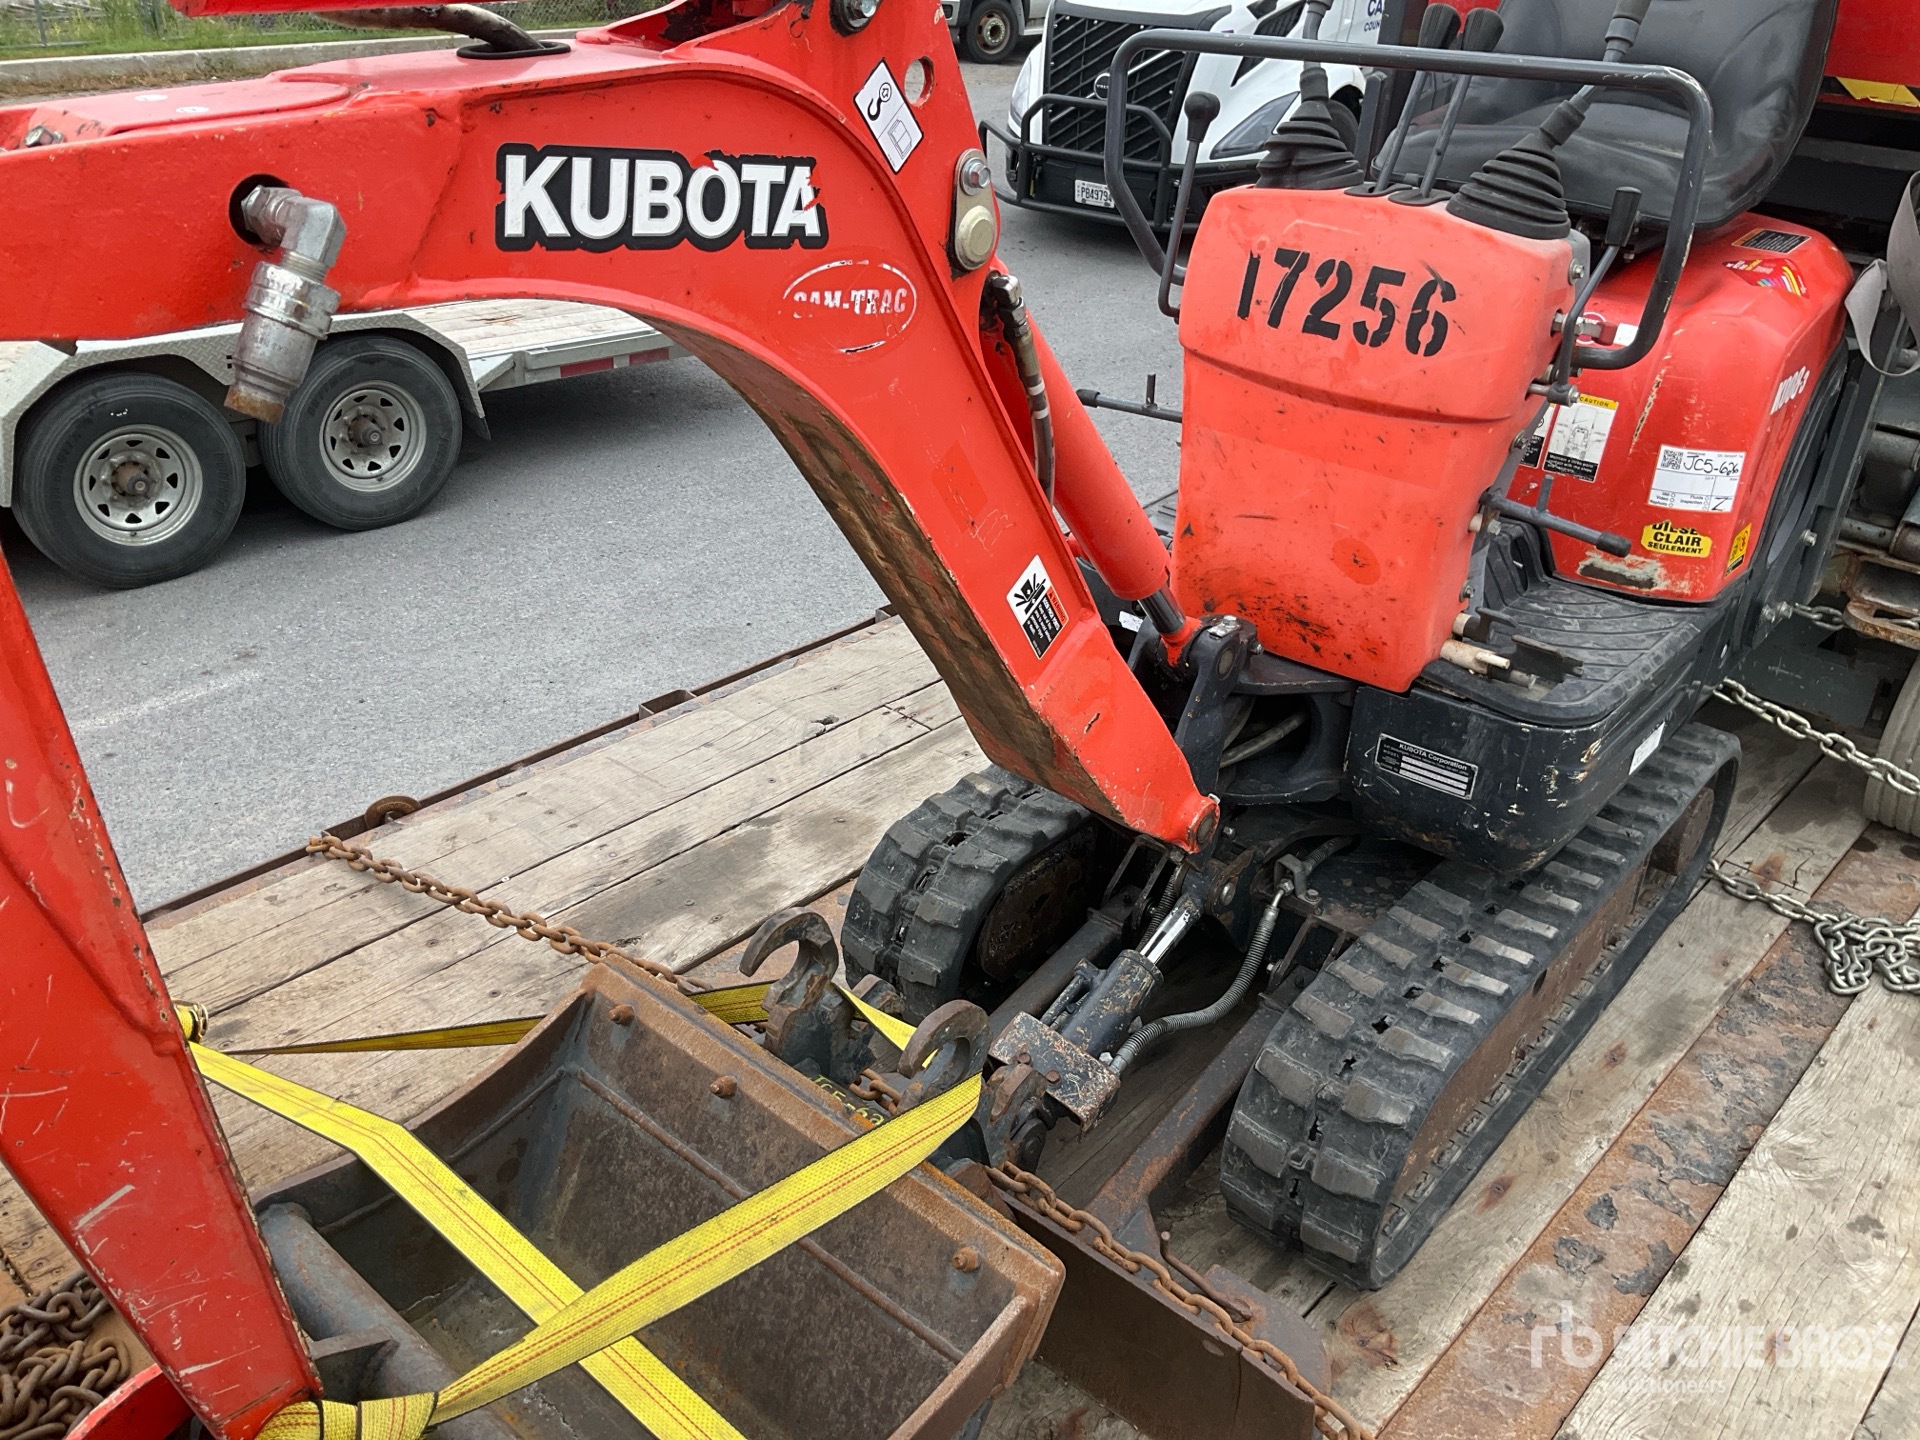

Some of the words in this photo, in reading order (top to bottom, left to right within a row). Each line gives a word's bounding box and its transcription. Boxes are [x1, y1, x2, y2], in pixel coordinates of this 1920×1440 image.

[504, 154, 821, 239] KUBOTA
[1237, 247, 1456, 357] 17256
[1580, 396, 1609, 407] CAUTION
[1647, 541, 1704, 554] SEULEMENT
[1653, 531, 1702, 547] CLAIR
[1399, 743, 1427, 758] KUBOTA
[1427, 752, 1468, 772] Corporation
